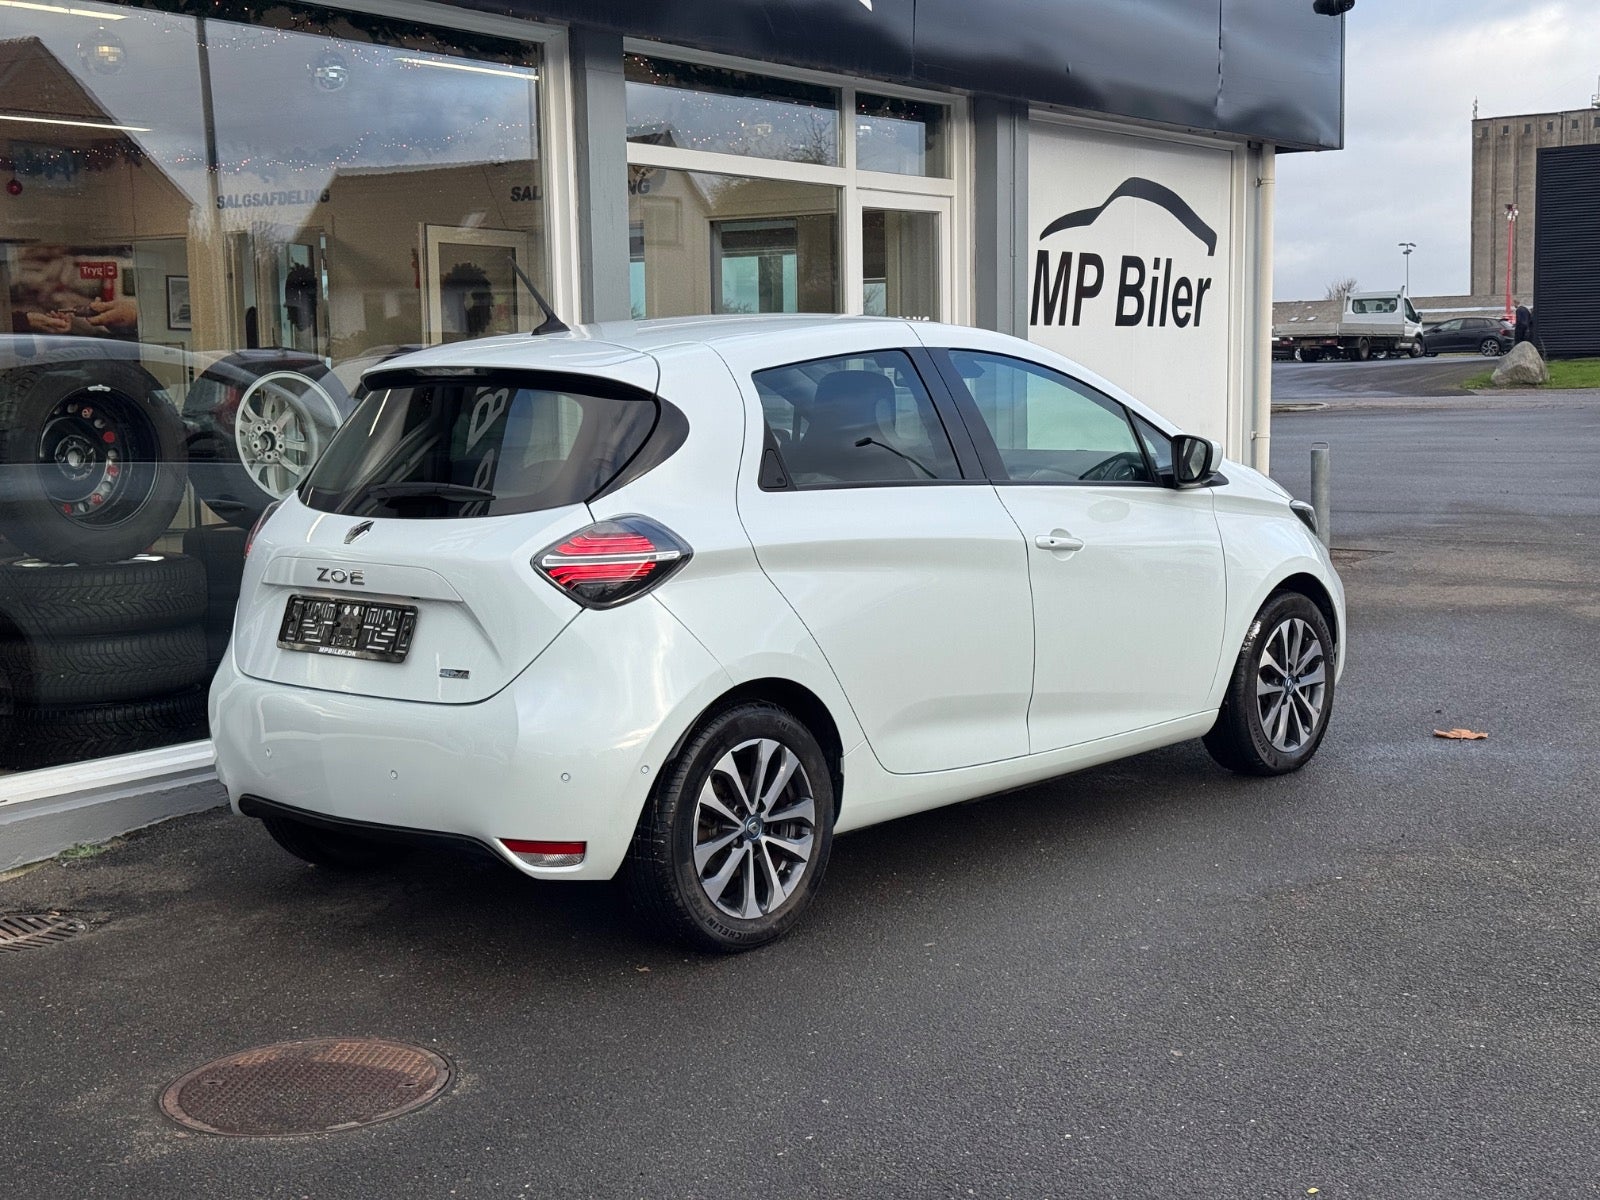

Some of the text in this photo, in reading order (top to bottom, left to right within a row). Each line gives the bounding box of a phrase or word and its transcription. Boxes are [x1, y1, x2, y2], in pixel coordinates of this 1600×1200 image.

[216, 189, 331, 209] SALGSAFDELING
[510, 178, 651, 202] SAL NG
[81, 265, 103, 276] Tryg
[1030, 249, 1212, 328] MP Biler
[316, 567, 365, 586] ZOE
